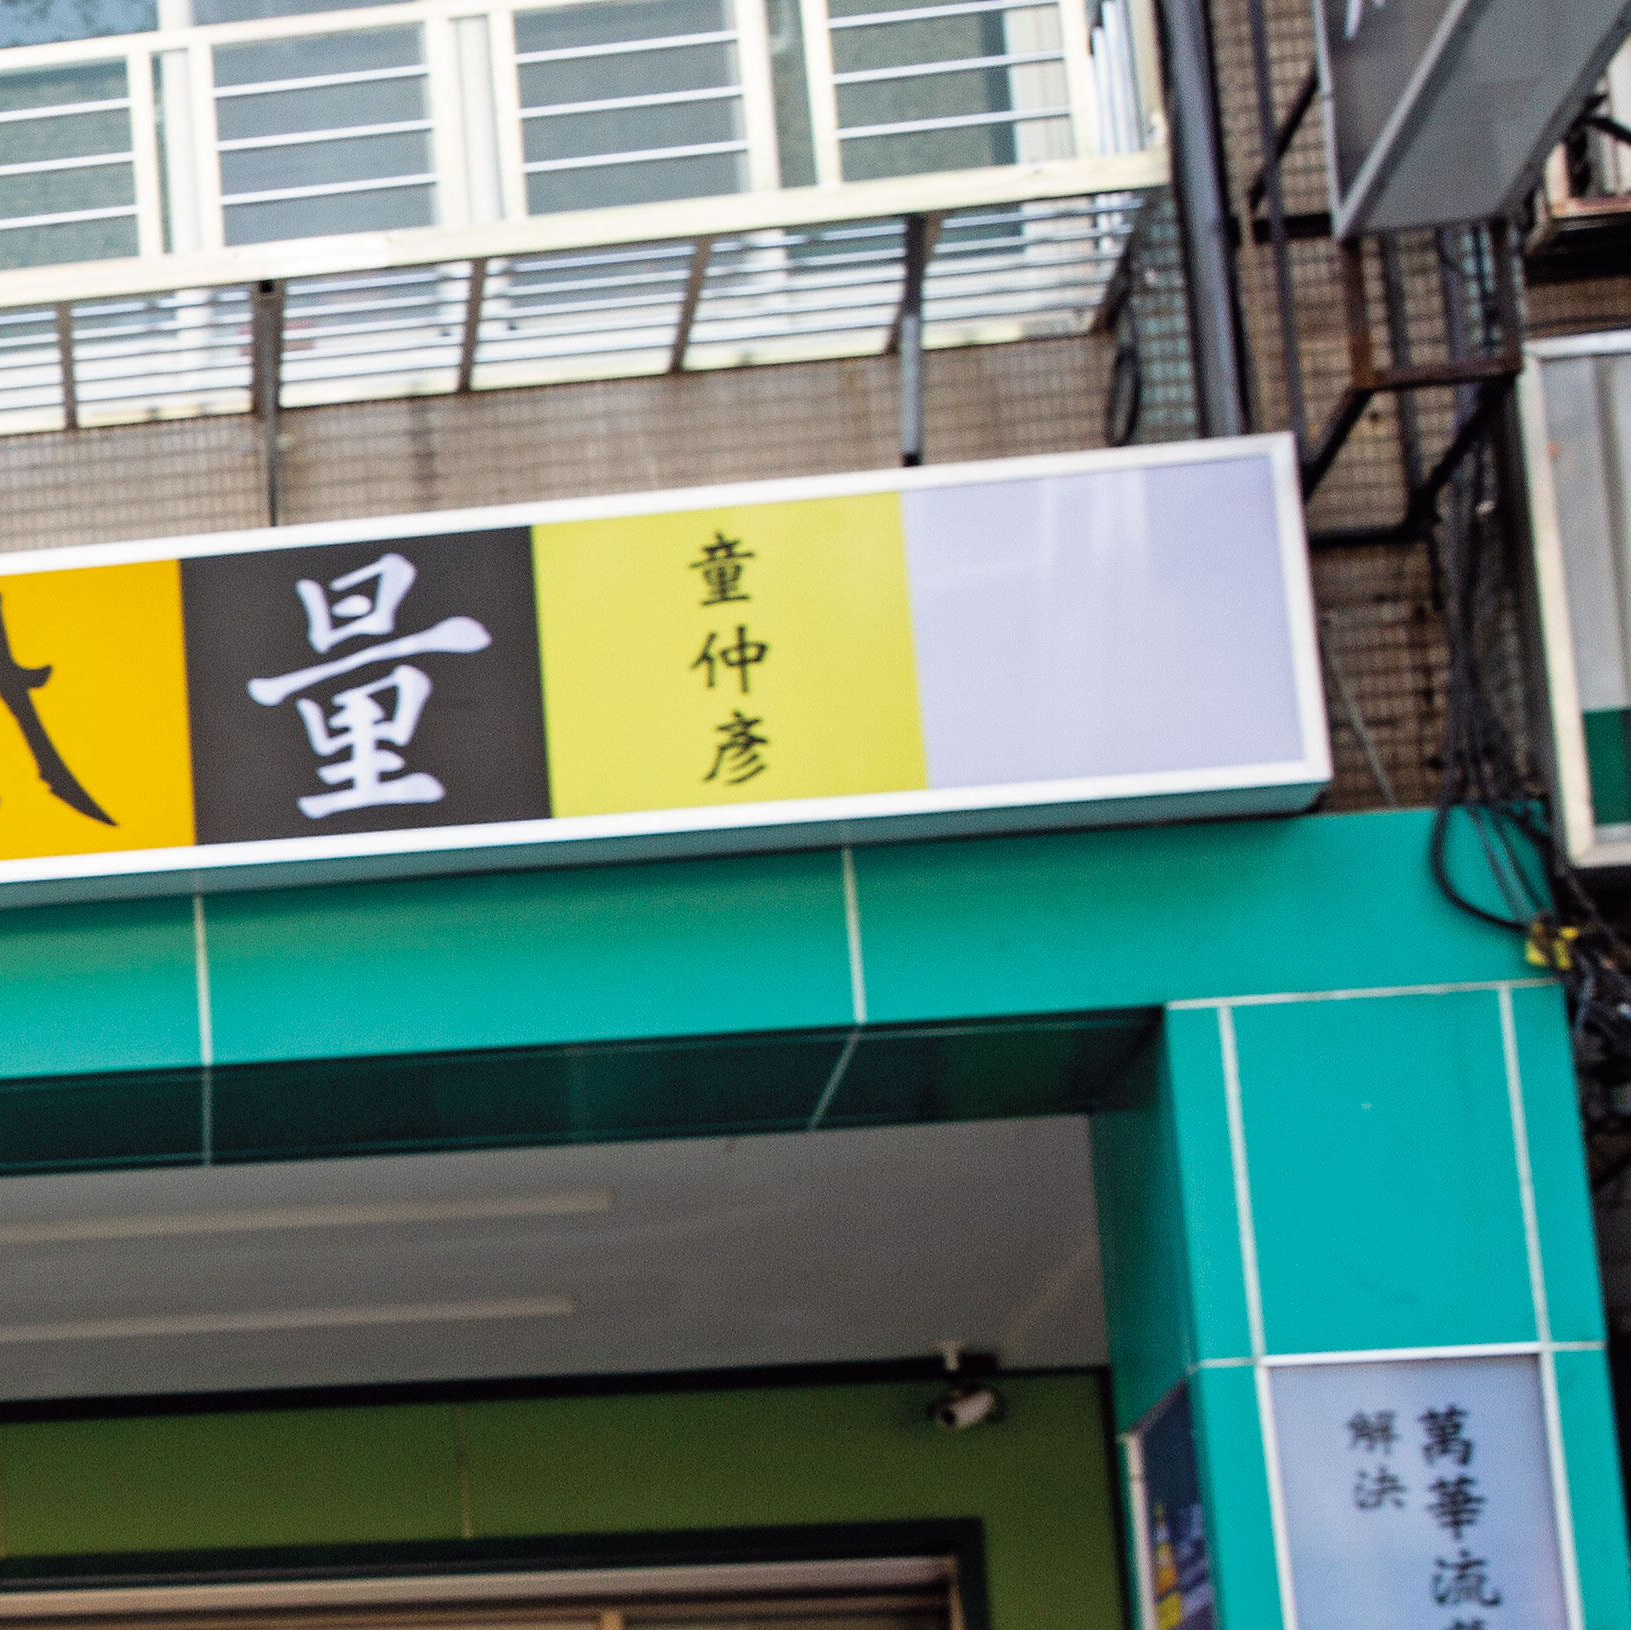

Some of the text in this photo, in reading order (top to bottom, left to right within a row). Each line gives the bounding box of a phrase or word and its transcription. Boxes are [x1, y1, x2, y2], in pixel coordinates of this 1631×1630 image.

[687, 531, 769, 786] 童仲彥
[1345, 1410, 1408, 1511] 解決
